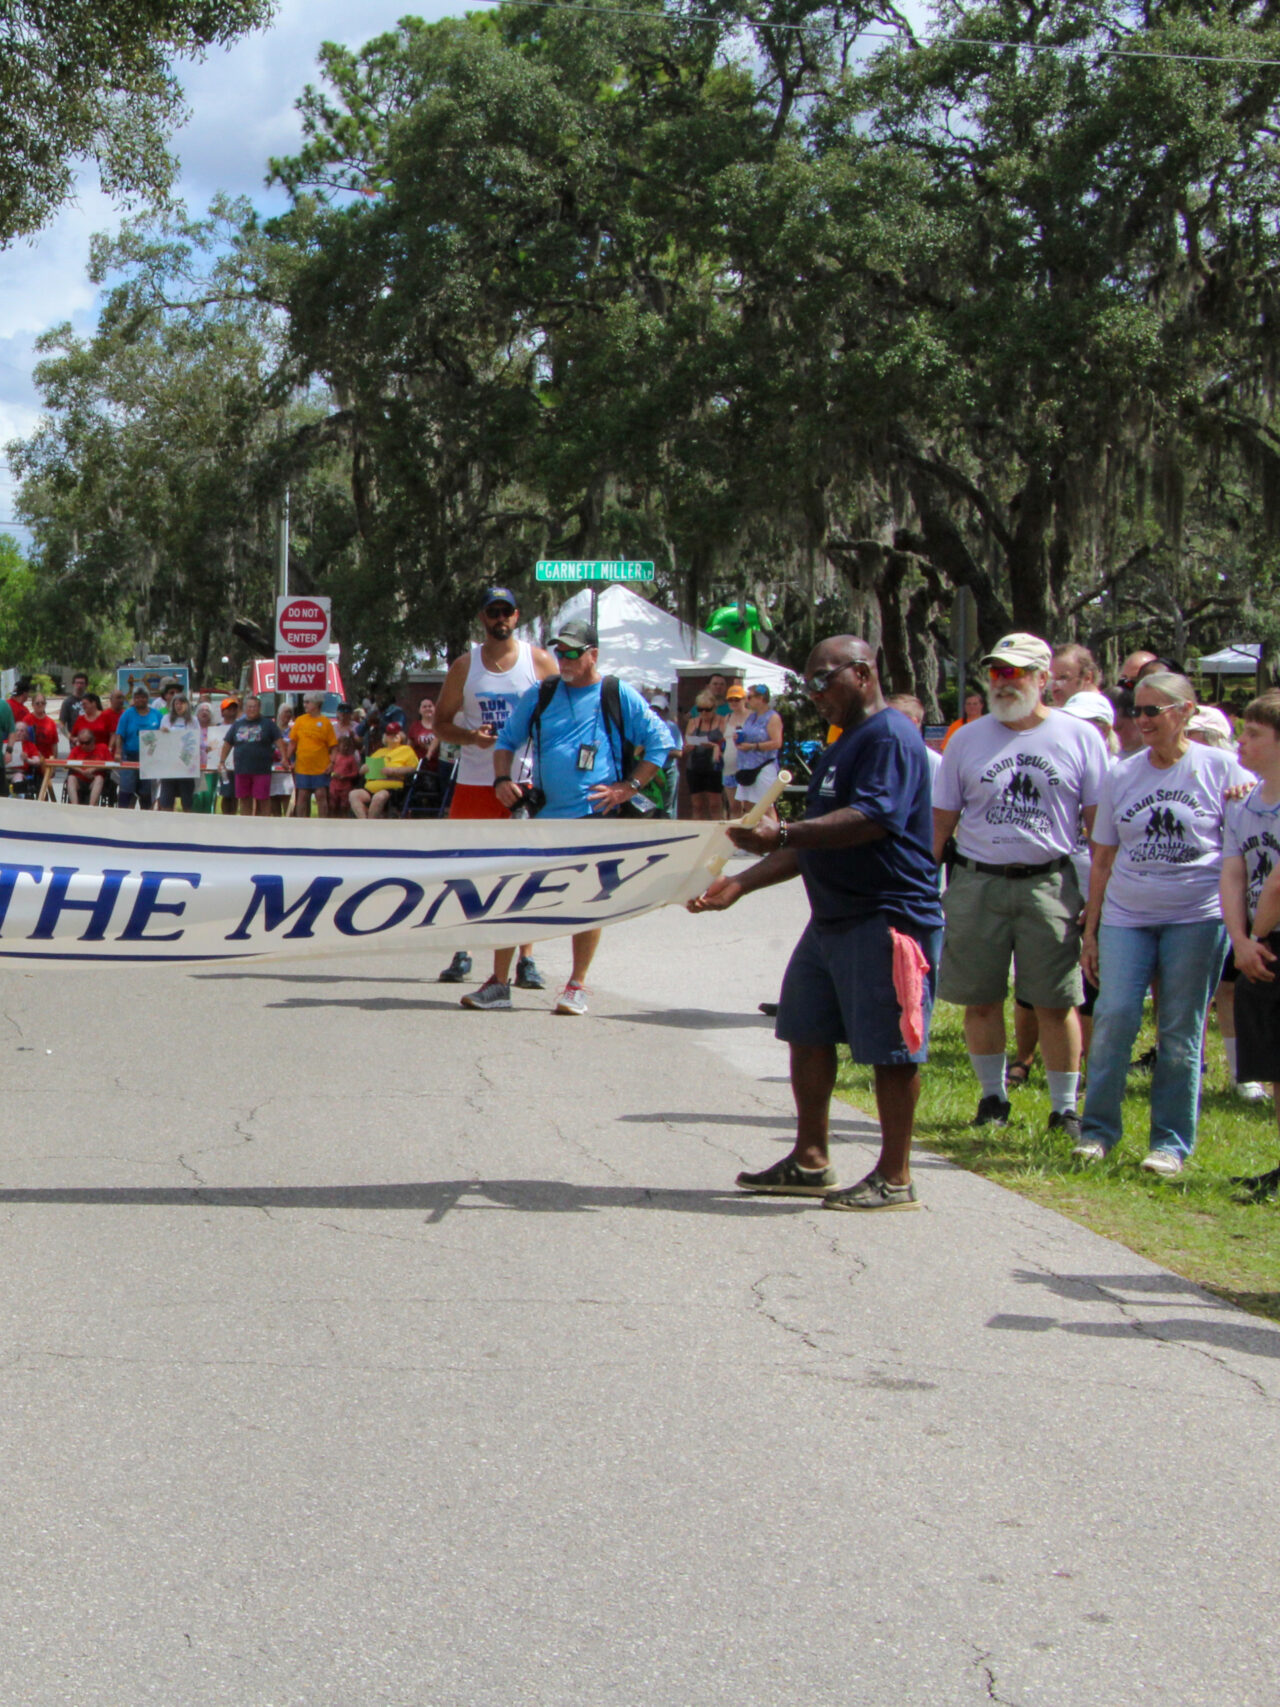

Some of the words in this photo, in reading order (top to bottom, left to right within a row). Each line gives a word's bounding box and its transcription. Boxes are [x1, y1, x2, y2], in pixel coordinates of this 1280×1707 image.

[545, 563, 595, 579] GARNETT
[601, 563, 642, 579] MILLER
[288, 608, 300, 618] DO
[302, 608, 319, 618] NOT
[288, 633, 318, 643] ENTER
[280, 663, 325, 673] WRONG
[288, 674, 315, 683] WAY
[478, 700, 506, 711] RUN
[980, 757, 1015, 784] Team
[1120, 794, 1156, 823] Team
[225, 852, 670, 940] MONEY
